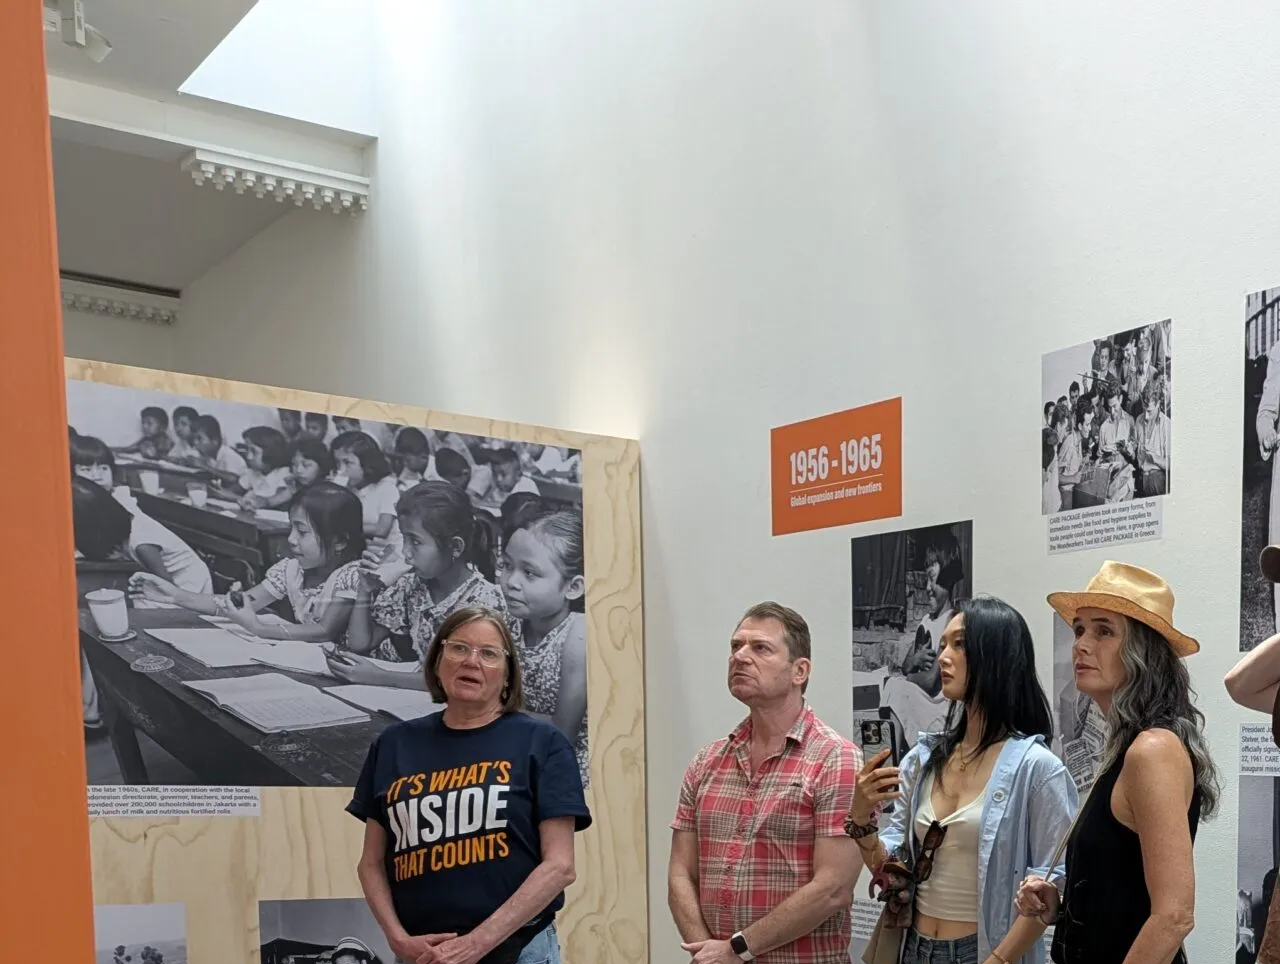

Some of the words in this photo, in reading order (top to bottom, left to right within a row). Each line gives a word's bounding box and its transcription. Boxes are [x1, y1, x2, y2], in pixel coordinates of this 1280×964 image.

[790, 494, 806, 507] Global
[807, 490, 834, 506] expansion
[834, 486, 844, 499] and
[845, 487, 856, 497] new
[858, 482, 882, 495] frontiers
[1050, 516, 1060, 524] CARE
[1061, 513, 1080, 522] PACKAGE
[1102, 507, 1110, 516] took
[1118, 506, 1130, 514] many
[1071, 522, 1083, 530] needs
[1111, 516, 1127, 525] hygiene
[1128, 512, 1146, 522] supplies
[1060, 532, 1073, 542] people
[1074, 530, 1085, 538] could
[1132, 522, 1145, 531] group
[1146, 520, 1159, 528] opens
[1101, 534, 1112, 544] CARE
[1113, 532, 1133, 542] PACKAGE
[1242, 765, 1263, 773] inaugural
[387, 773, 426, 804] IT'S
[428, 760, 512, 792] WHAT'S
[387, 784, 510, 853] INSIDE
[394, 848, 428, 882] THAT
[430, 832, 510, 872] COUNTS
